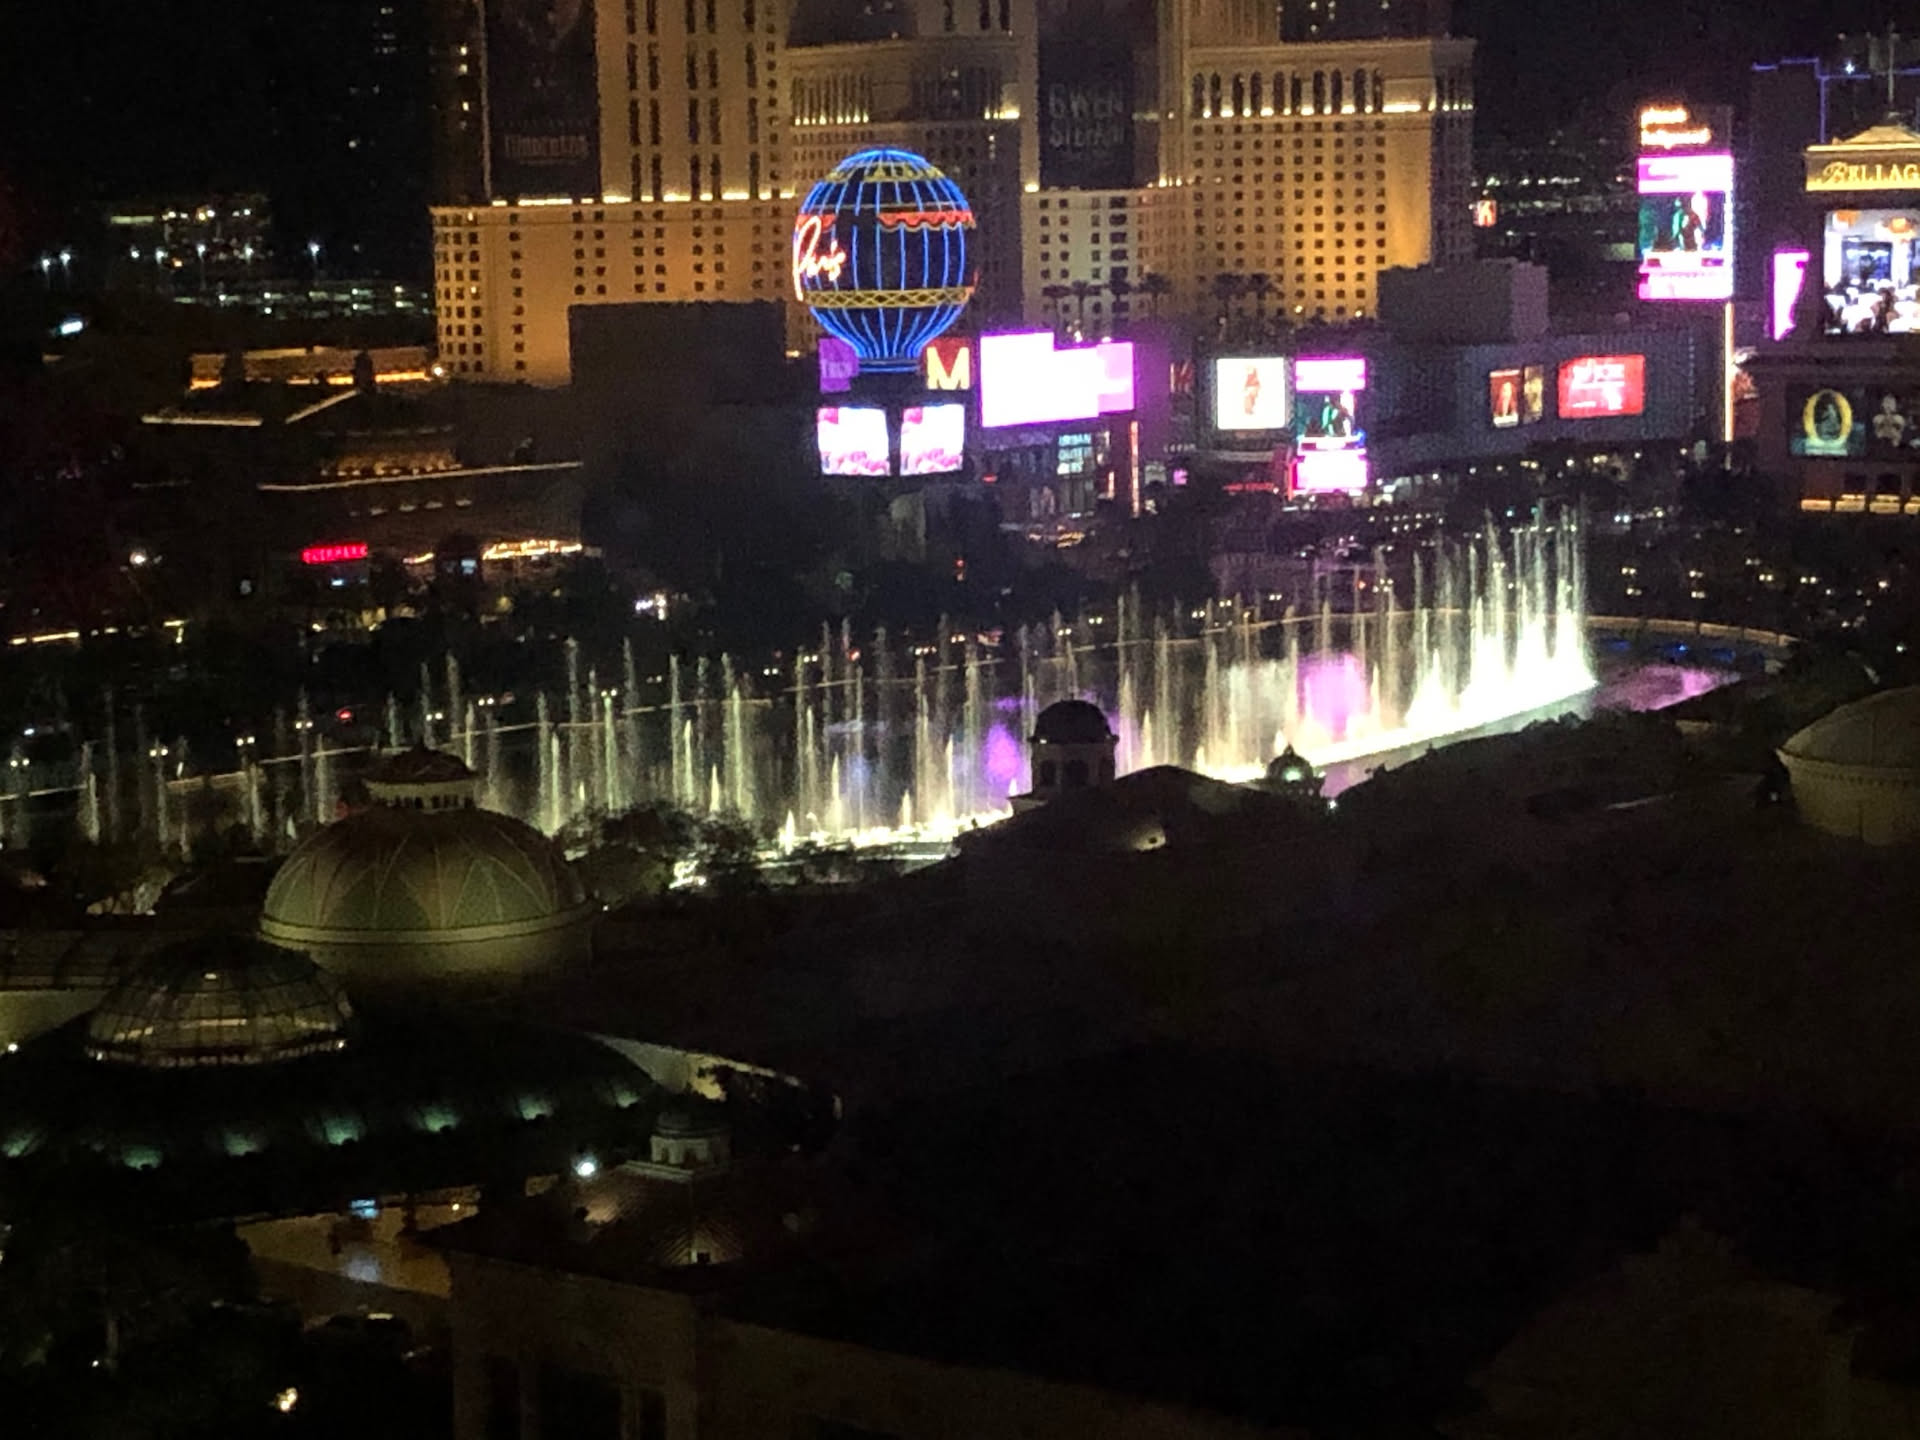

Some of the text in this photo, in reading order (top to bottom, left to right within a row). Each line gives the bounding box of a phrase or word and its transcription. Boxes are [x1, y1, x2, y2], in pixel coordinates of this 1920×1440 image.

[792, 215, 846, 302] Paris
[926, 346, 970, 390] M
[1803, 389, 1852, 446] O
